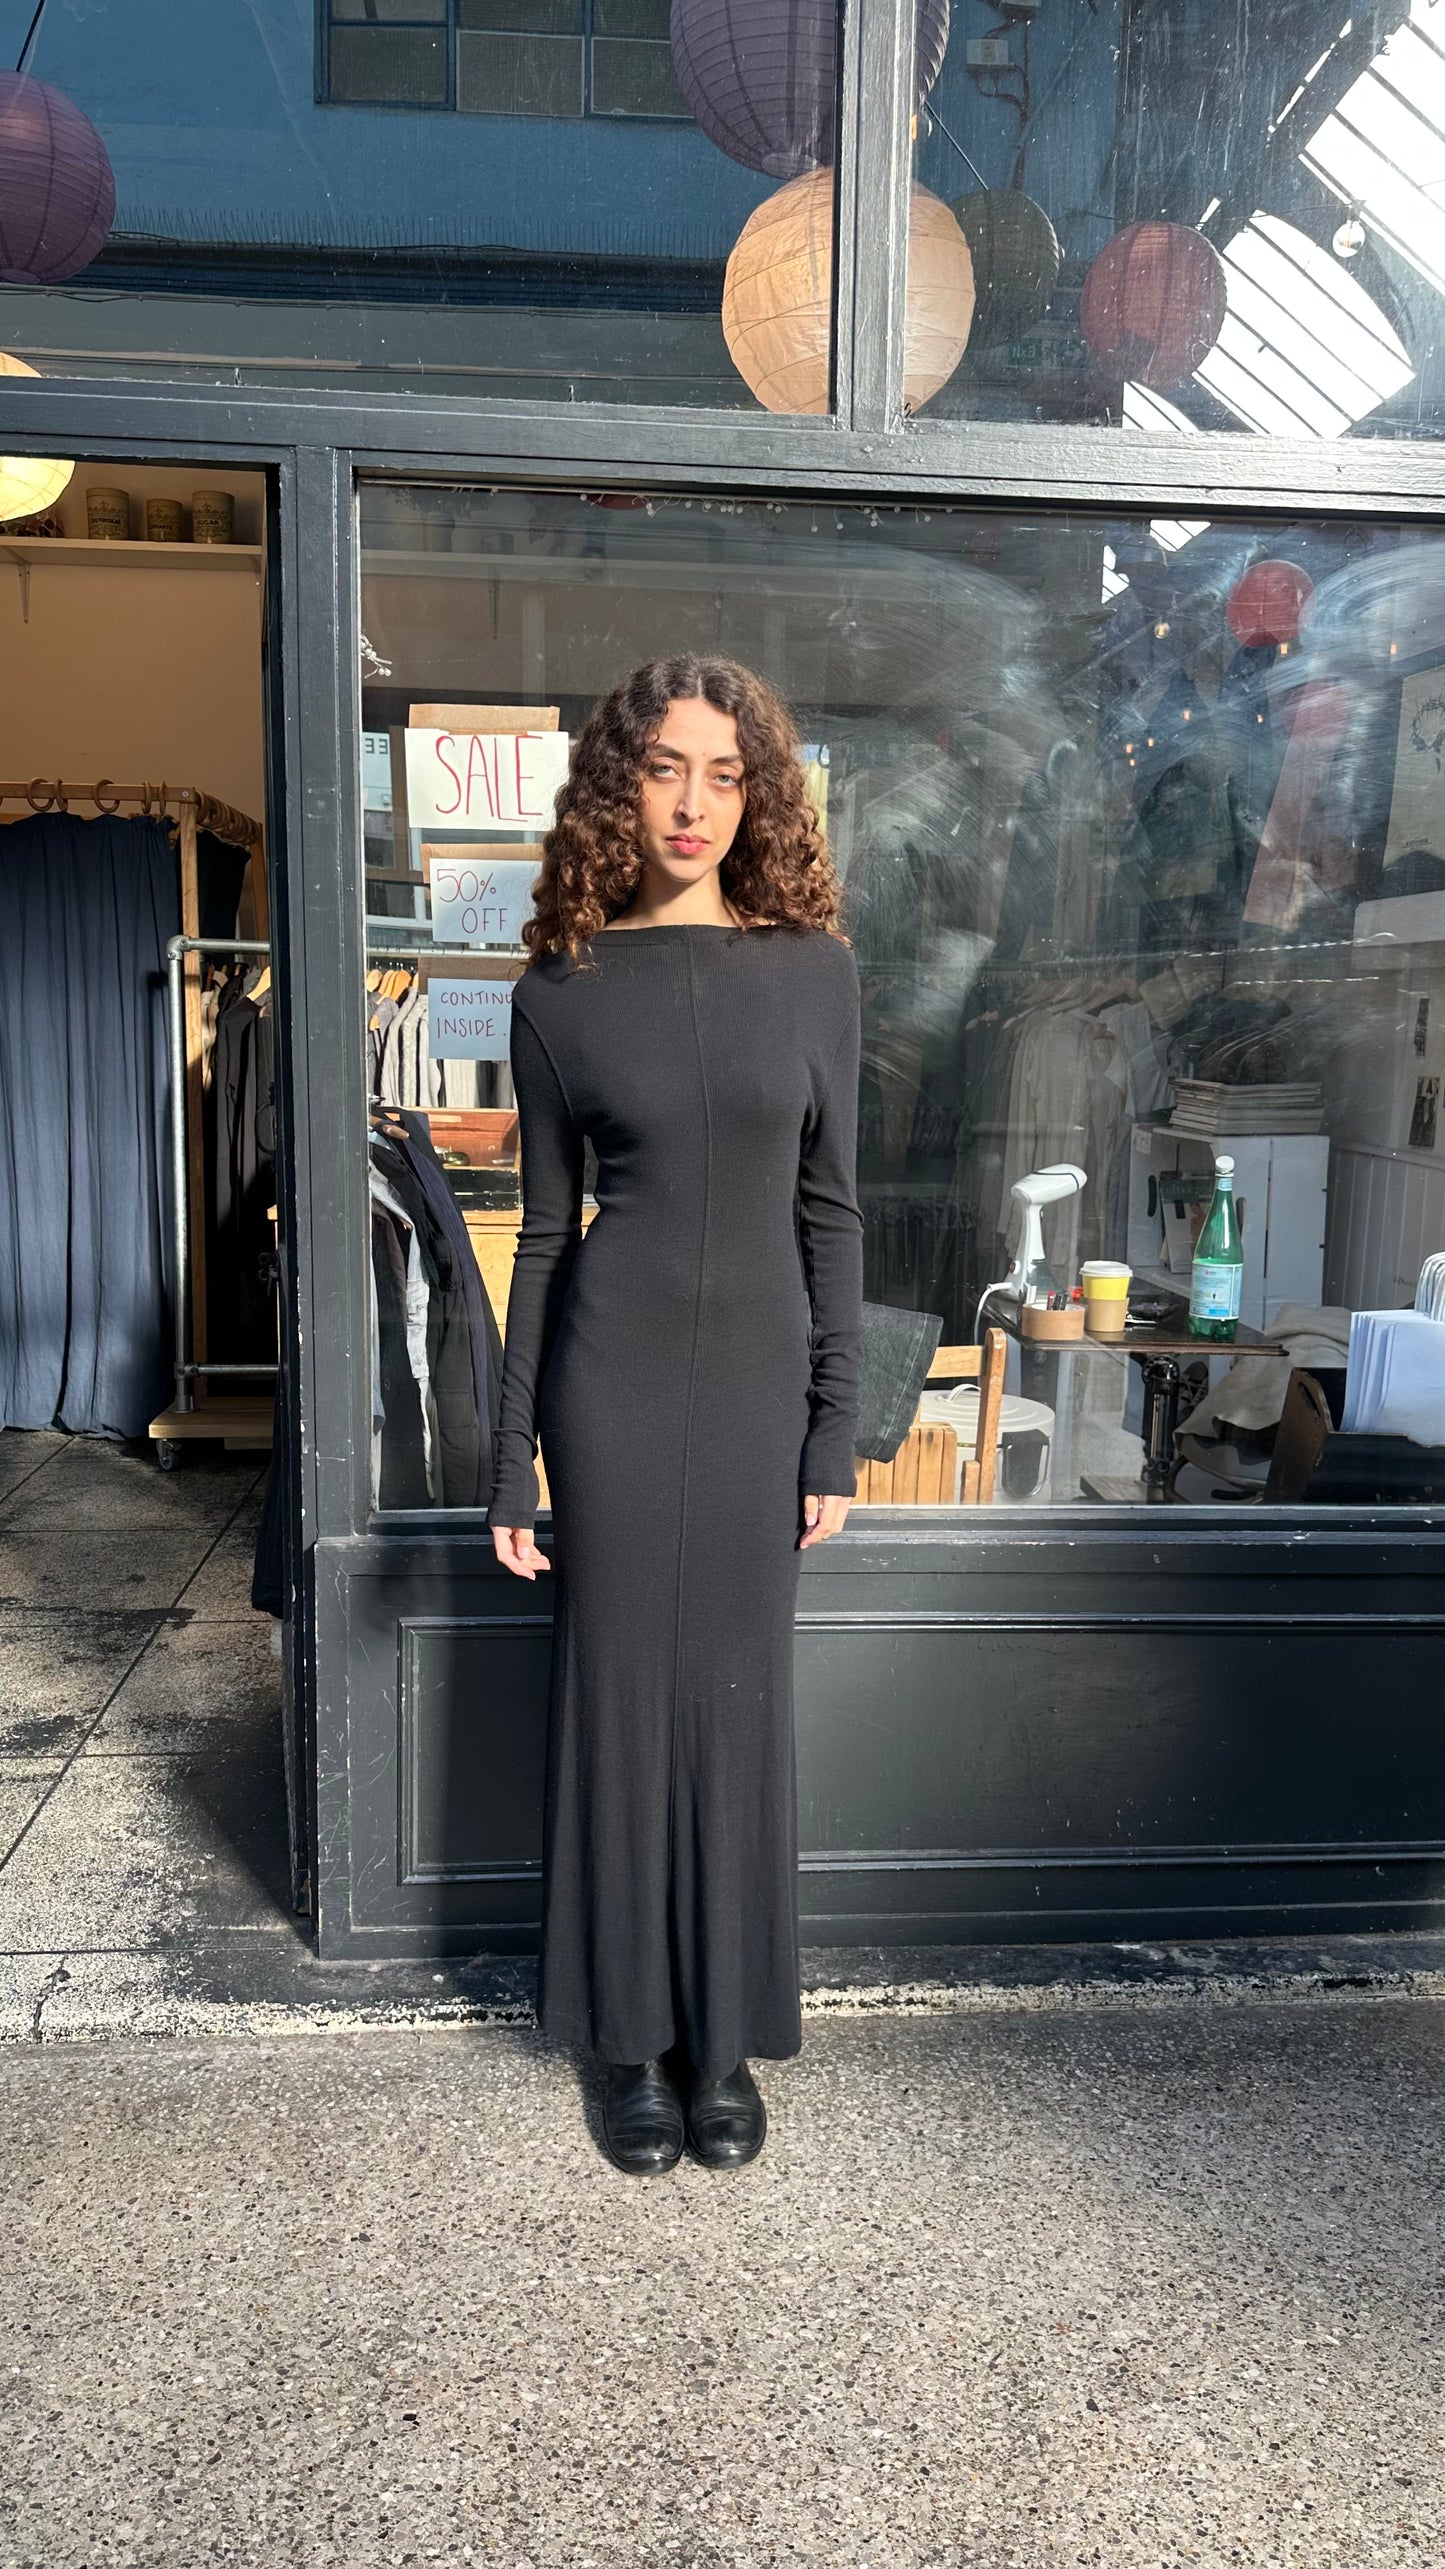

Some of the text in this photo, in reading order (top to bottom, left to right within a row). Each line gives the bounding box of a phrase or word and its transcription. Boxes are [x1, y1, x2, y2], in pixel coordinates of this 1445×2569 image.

[435, 735, 543, 823] SALE
[436, 868, 497, 903] 50%
[461, 907, 508, 934] OFF
